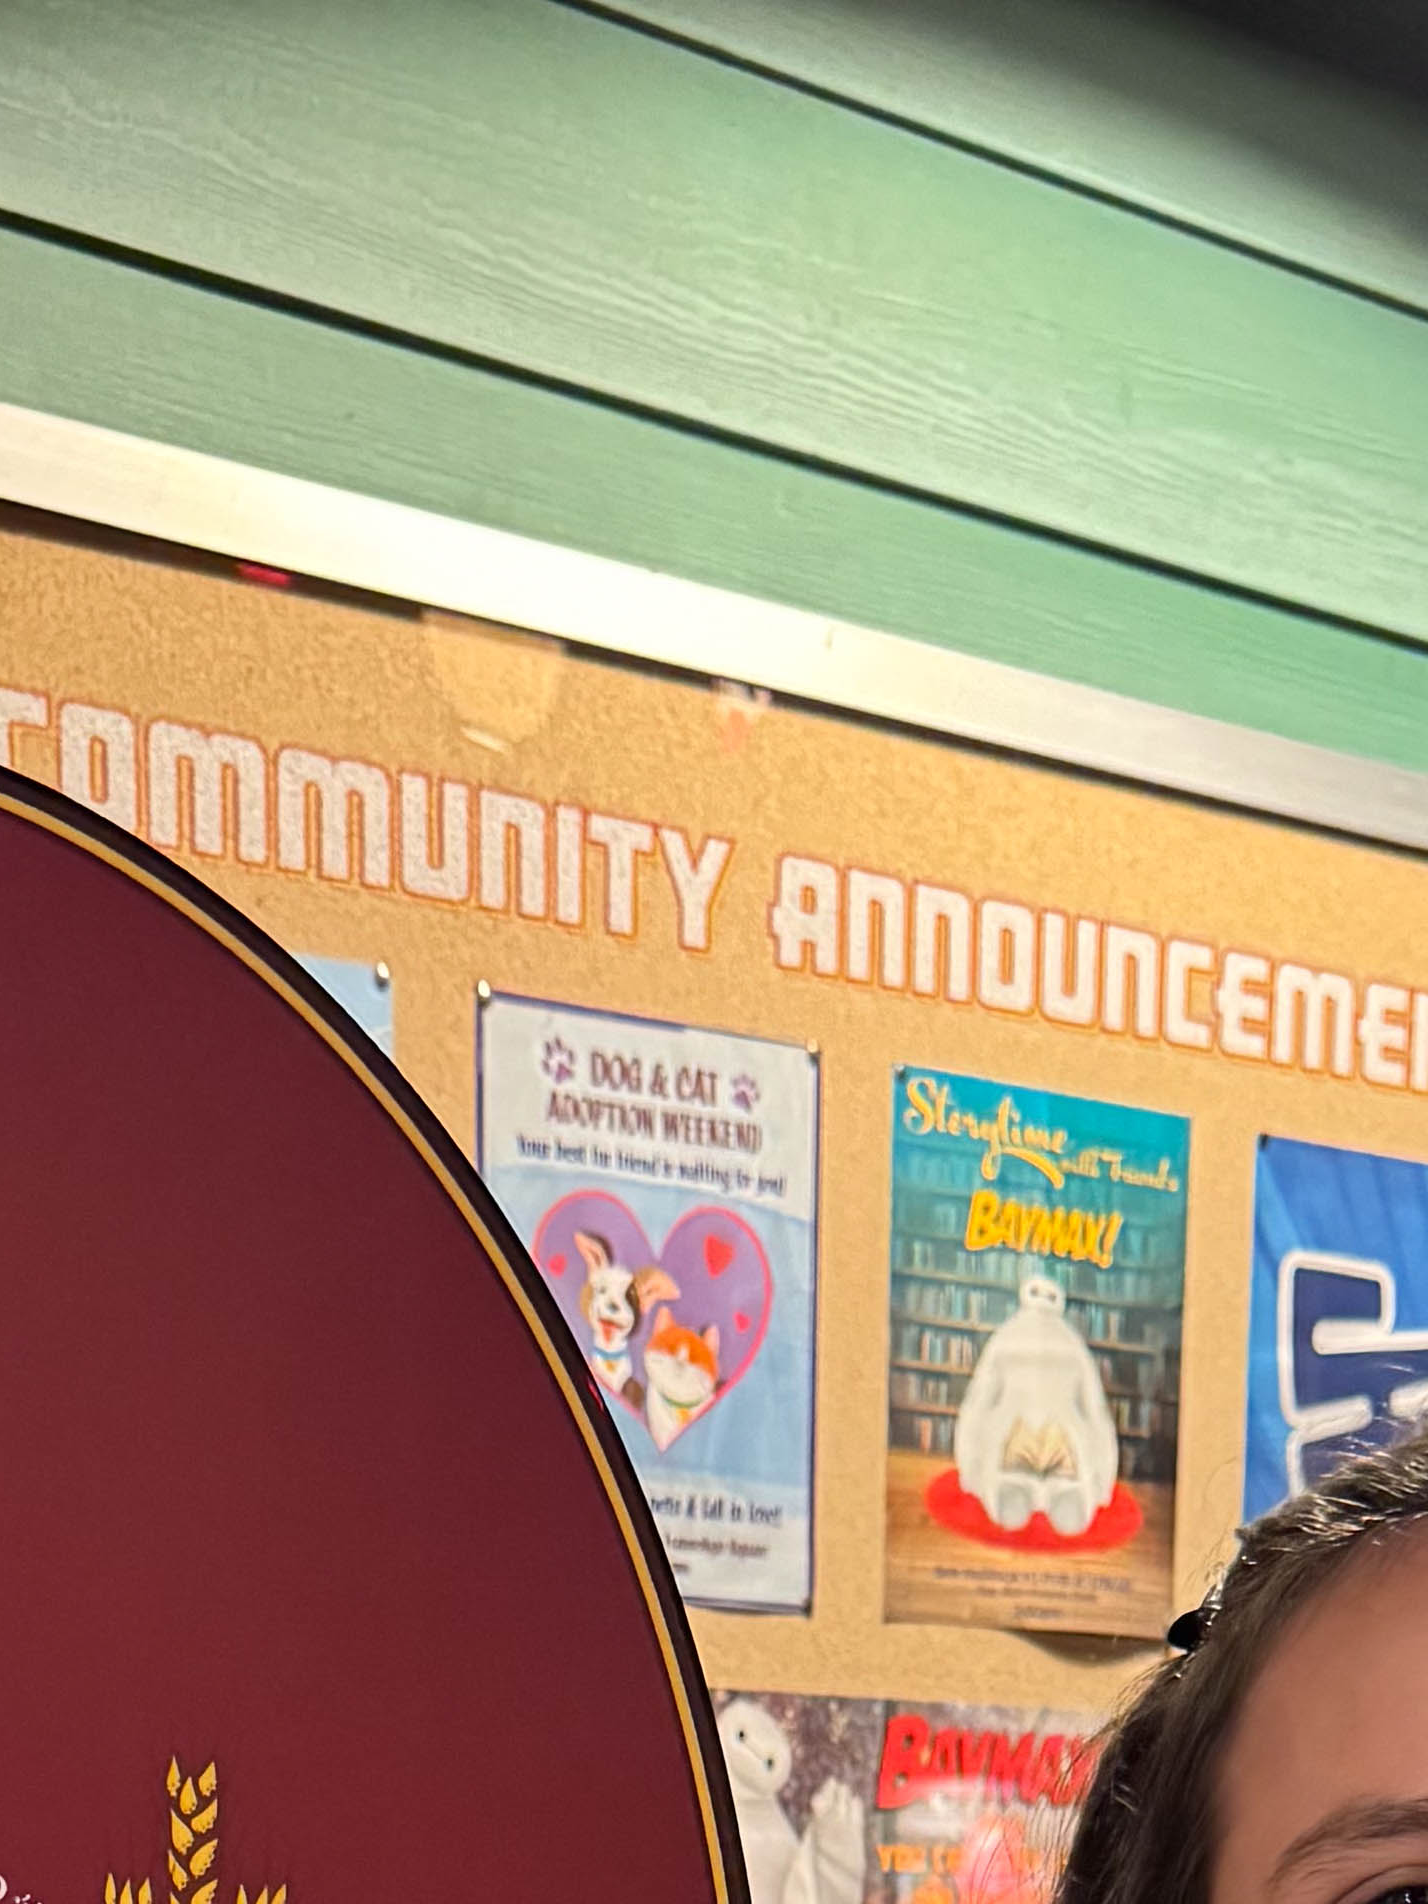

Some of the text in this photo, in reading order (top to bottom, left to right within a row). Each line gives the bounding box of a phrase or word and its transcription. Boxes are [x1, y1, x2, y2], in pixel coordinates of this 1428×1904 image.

[590, 1049, 719, 1106] DOG & CAT
[546, 1090, 763, 1154] ADOPTION WEEKEND
[902, 1077, 1069, 1184] Storytime
[964, 1188, 1124, 1269] BAYMAX!
